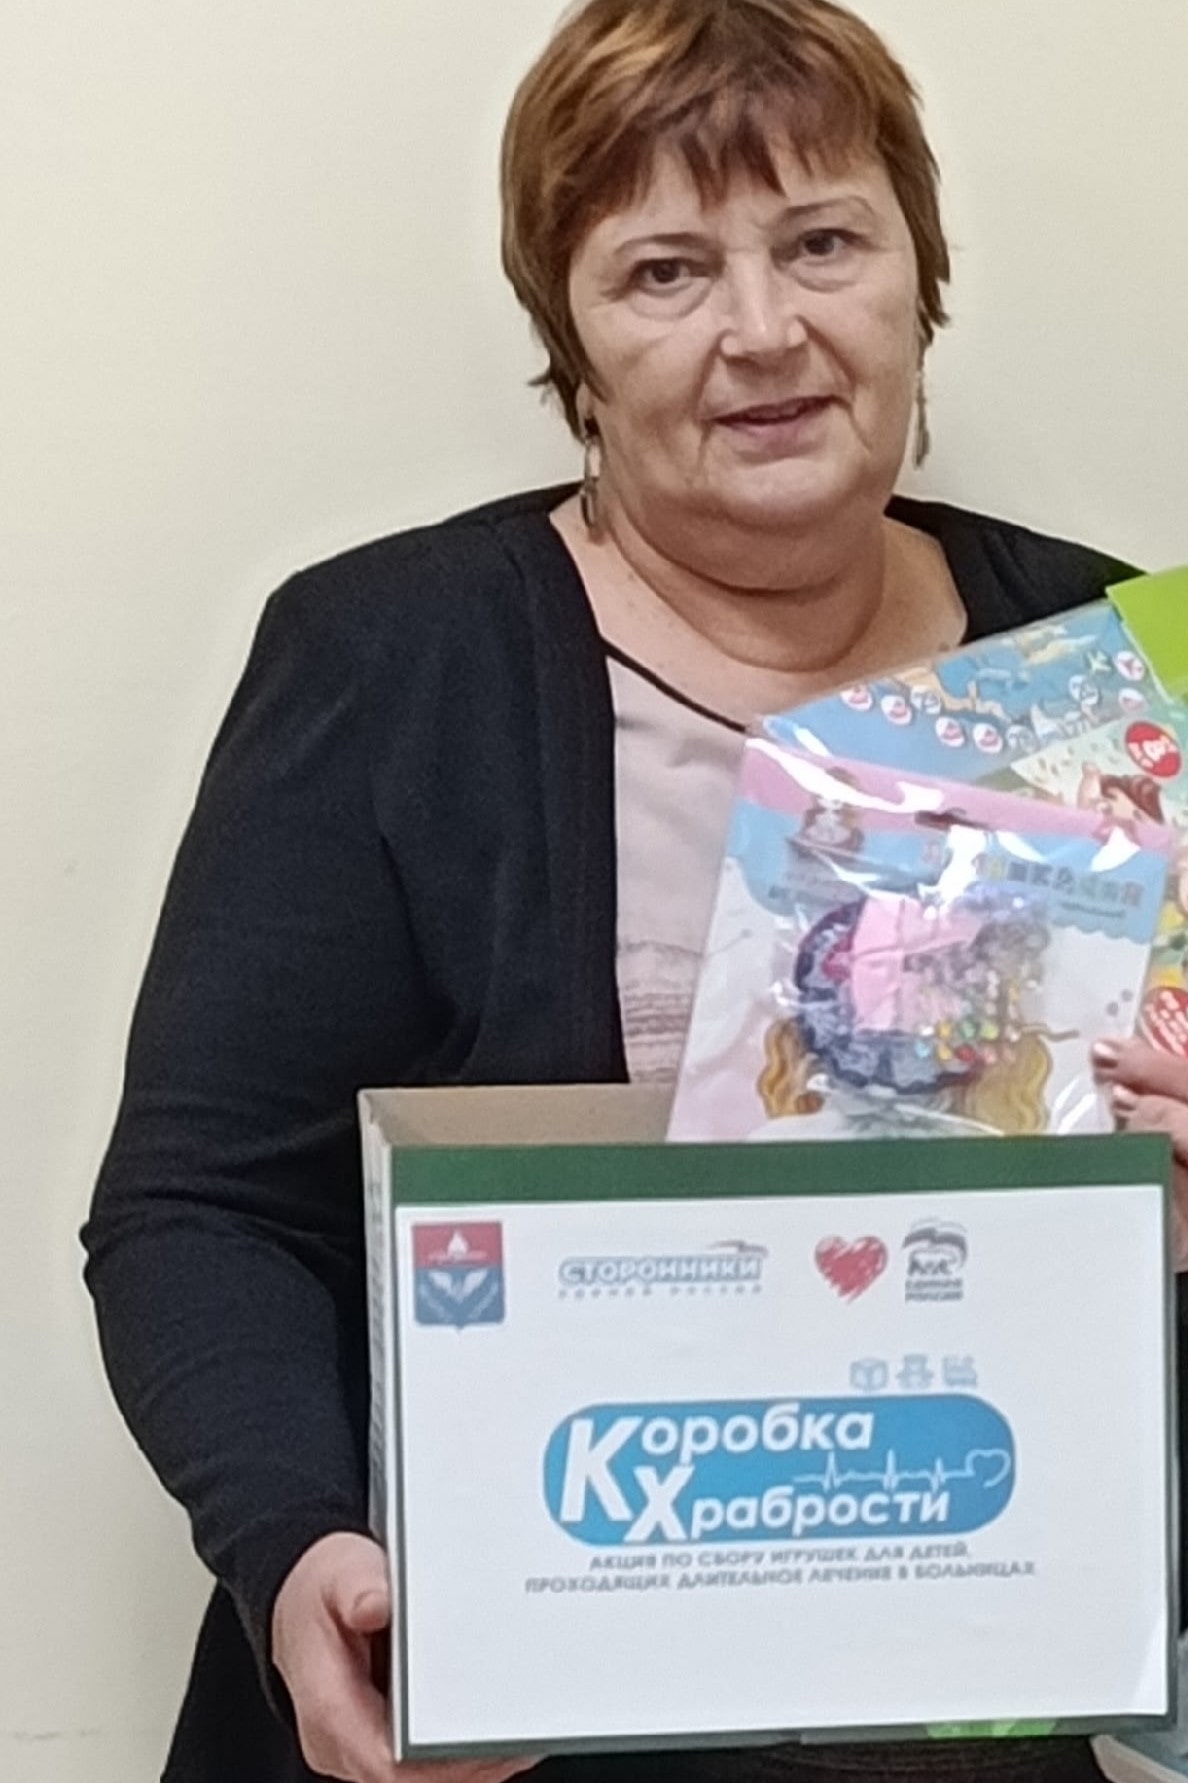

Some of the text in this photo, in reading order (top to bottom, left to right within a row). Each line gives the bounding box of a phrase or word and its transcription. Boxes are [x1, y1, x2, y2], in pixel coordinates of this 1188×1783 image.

[560, 1255, 761, 1286] СТОРОННИКИ
[560, 1403, 875, 1523] Коробка
[623, 1464, 951, 1543] Храбрости
[589, 1554, 657, 1571] АКЦИЯ
[661, 1553, 693, 1567] ПО
[697, 1551, 766, 1567] СБОРУ
[771, 1547, 857, 1563] ИГРУШЕК
[864, 1546, 904, 1561] ДЛЯ
[525, 1560, 1036, 1594] ПРОХОДЯЩИХ ДЛИТЕЛЬНОЕ ЛЕЧЕНИЕ В БОЛЬНИЦАХ
